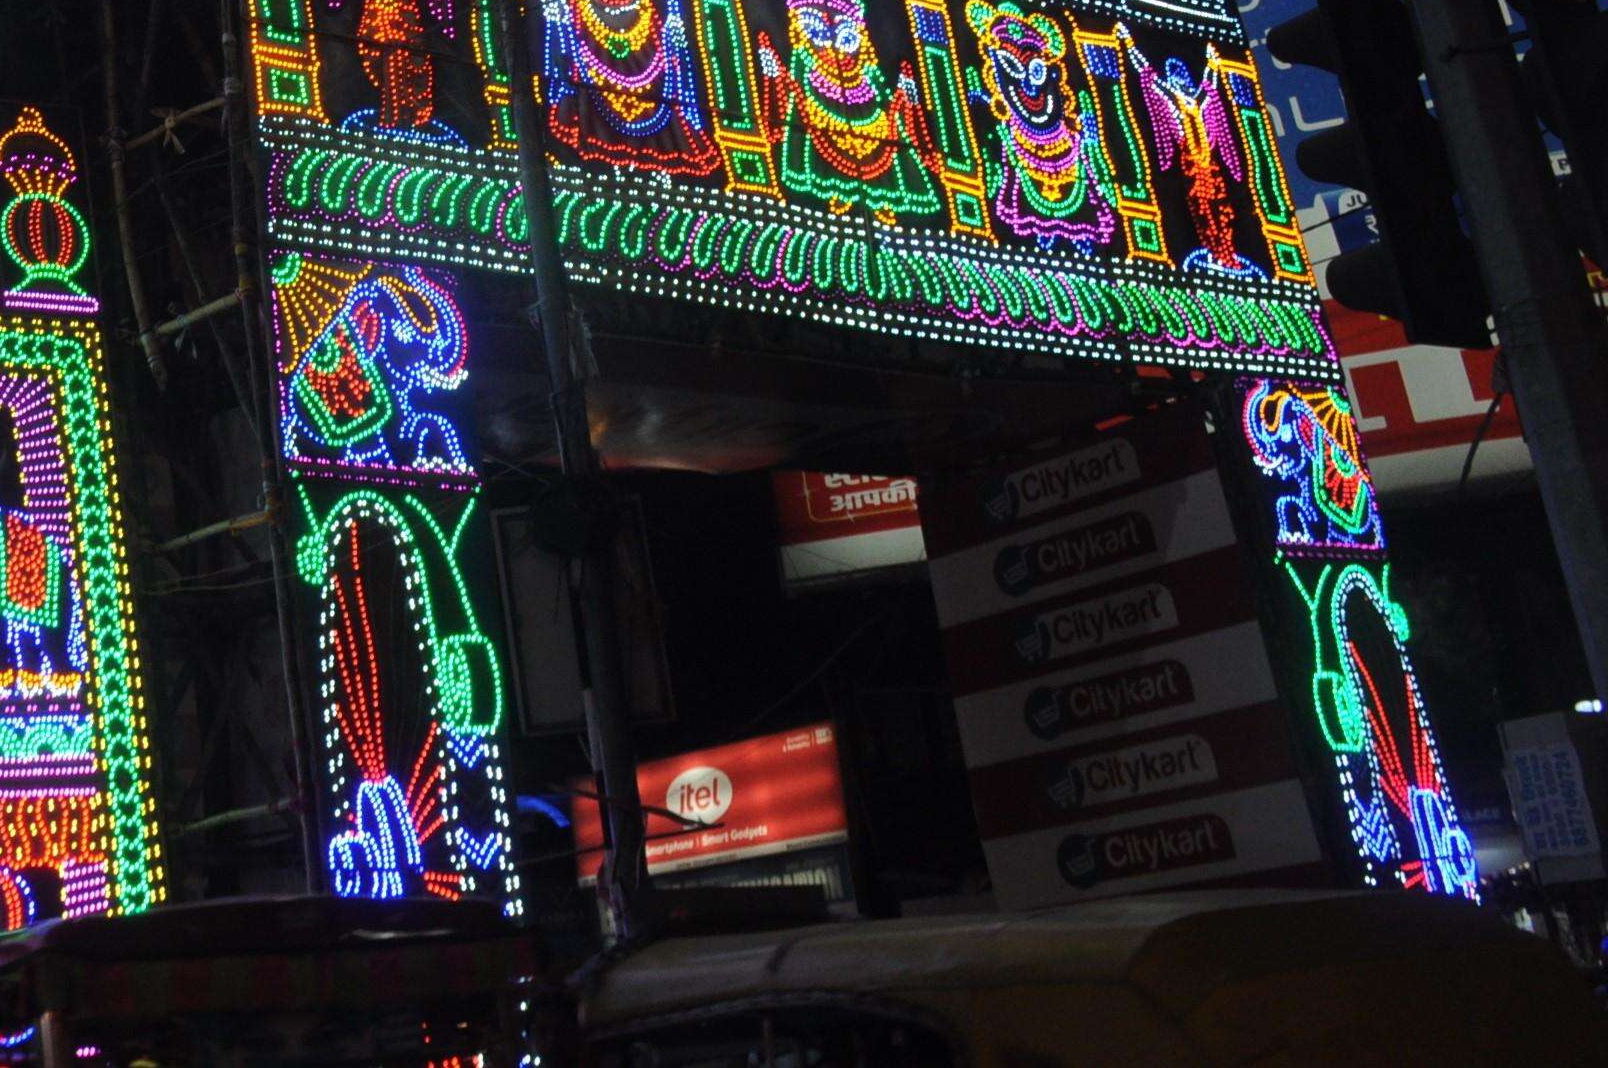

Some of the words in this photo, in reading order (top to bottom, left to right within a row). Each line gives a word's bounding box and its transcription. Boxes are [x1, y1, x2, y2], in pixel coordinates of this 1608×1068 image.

[1020, 445, 1125, 502] Citykart
[1039, 516, 1141, 572] Citykart
[1053, 589, 1162, 644] Citykart
[1069, 666, 1178, 716] Citykart
[1085, 739, 1199, 792] Citykart
[679, 776, 722, 814] itel
[645, 838, 695, 856] martphone
[1104, 820, 1217, 869] Citykart
